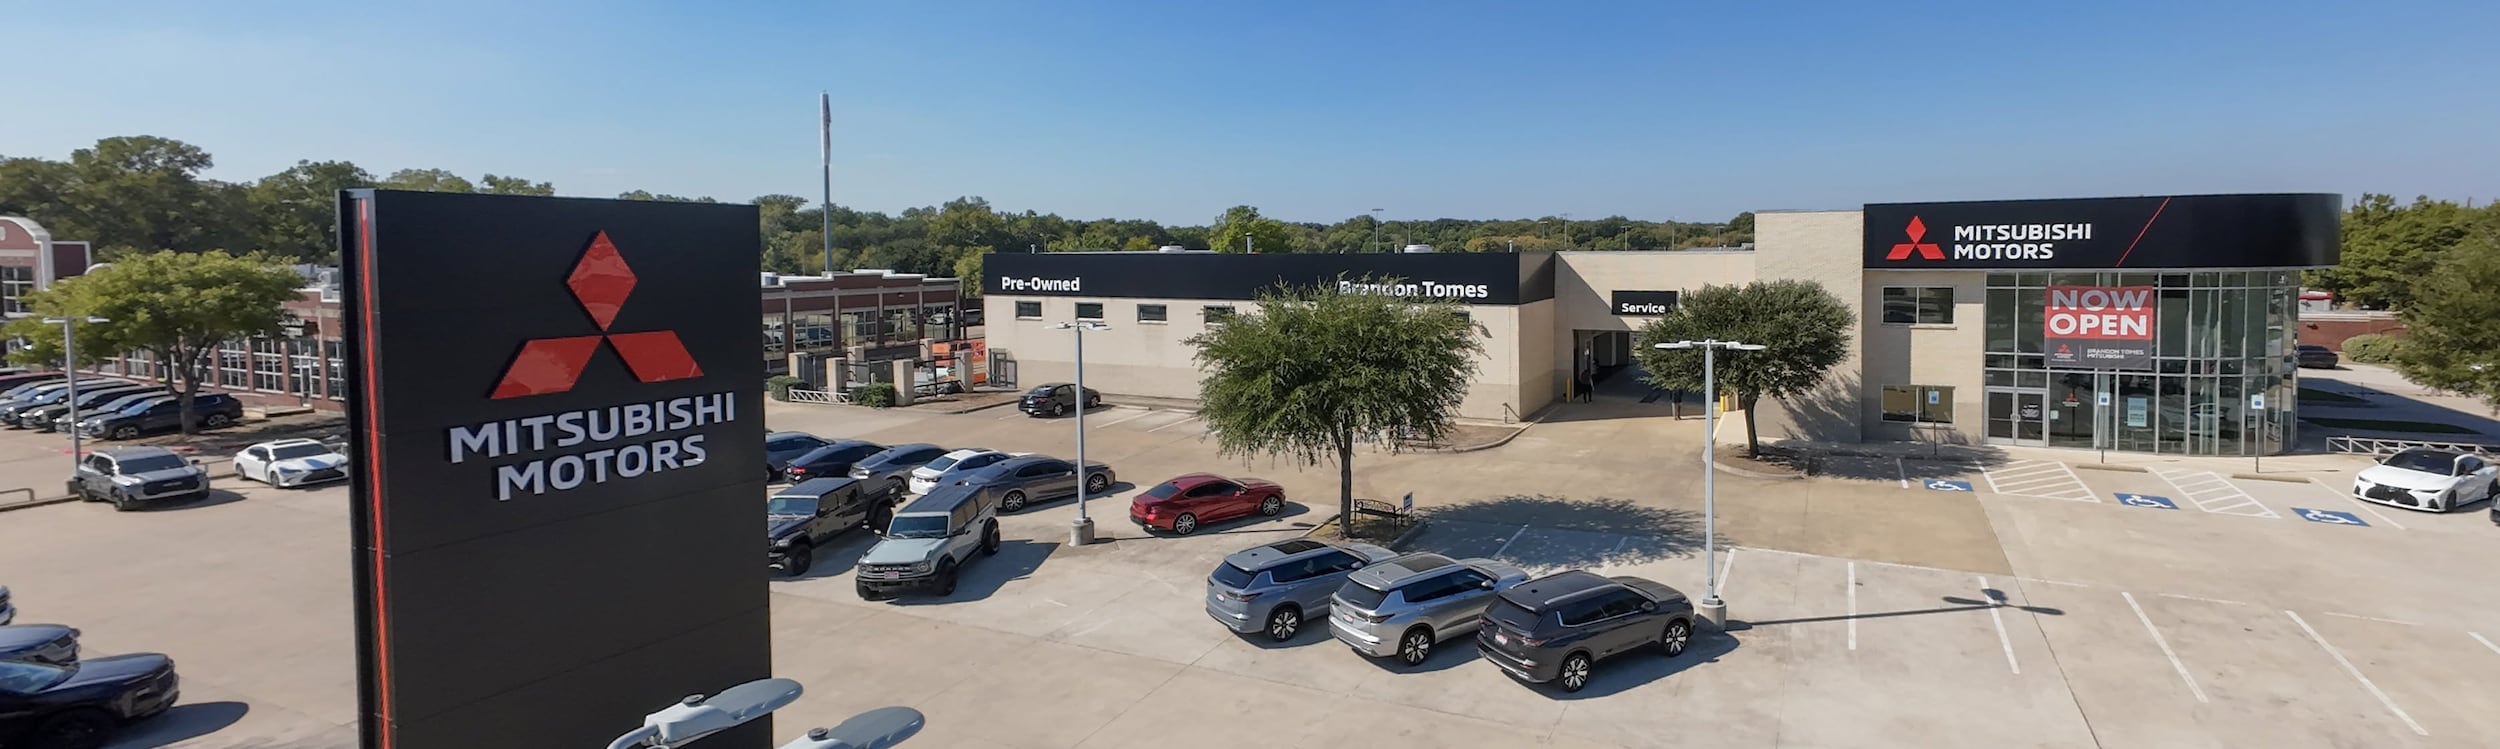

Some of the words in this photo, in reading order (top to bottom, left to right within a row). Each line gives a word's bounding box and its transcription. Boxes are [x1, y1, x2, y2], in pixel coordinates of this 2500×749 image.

[1954, 223, 2092, 241] MITSUBISHI
[1954, 243, 2054, 260] MOTORS
[1001, 276, 1081, 292] Pre-Owned
[1422, 281, 1488, 298] Tomes
[1621, 302, 1666, 313] Service
[2052, 290, 2149, 311] NOW
[2049, 313, 2147, 336] OPEN
[450, 392, 735, 464] MITSUBISHI
[498, 434, 706, 501] MOTORS
